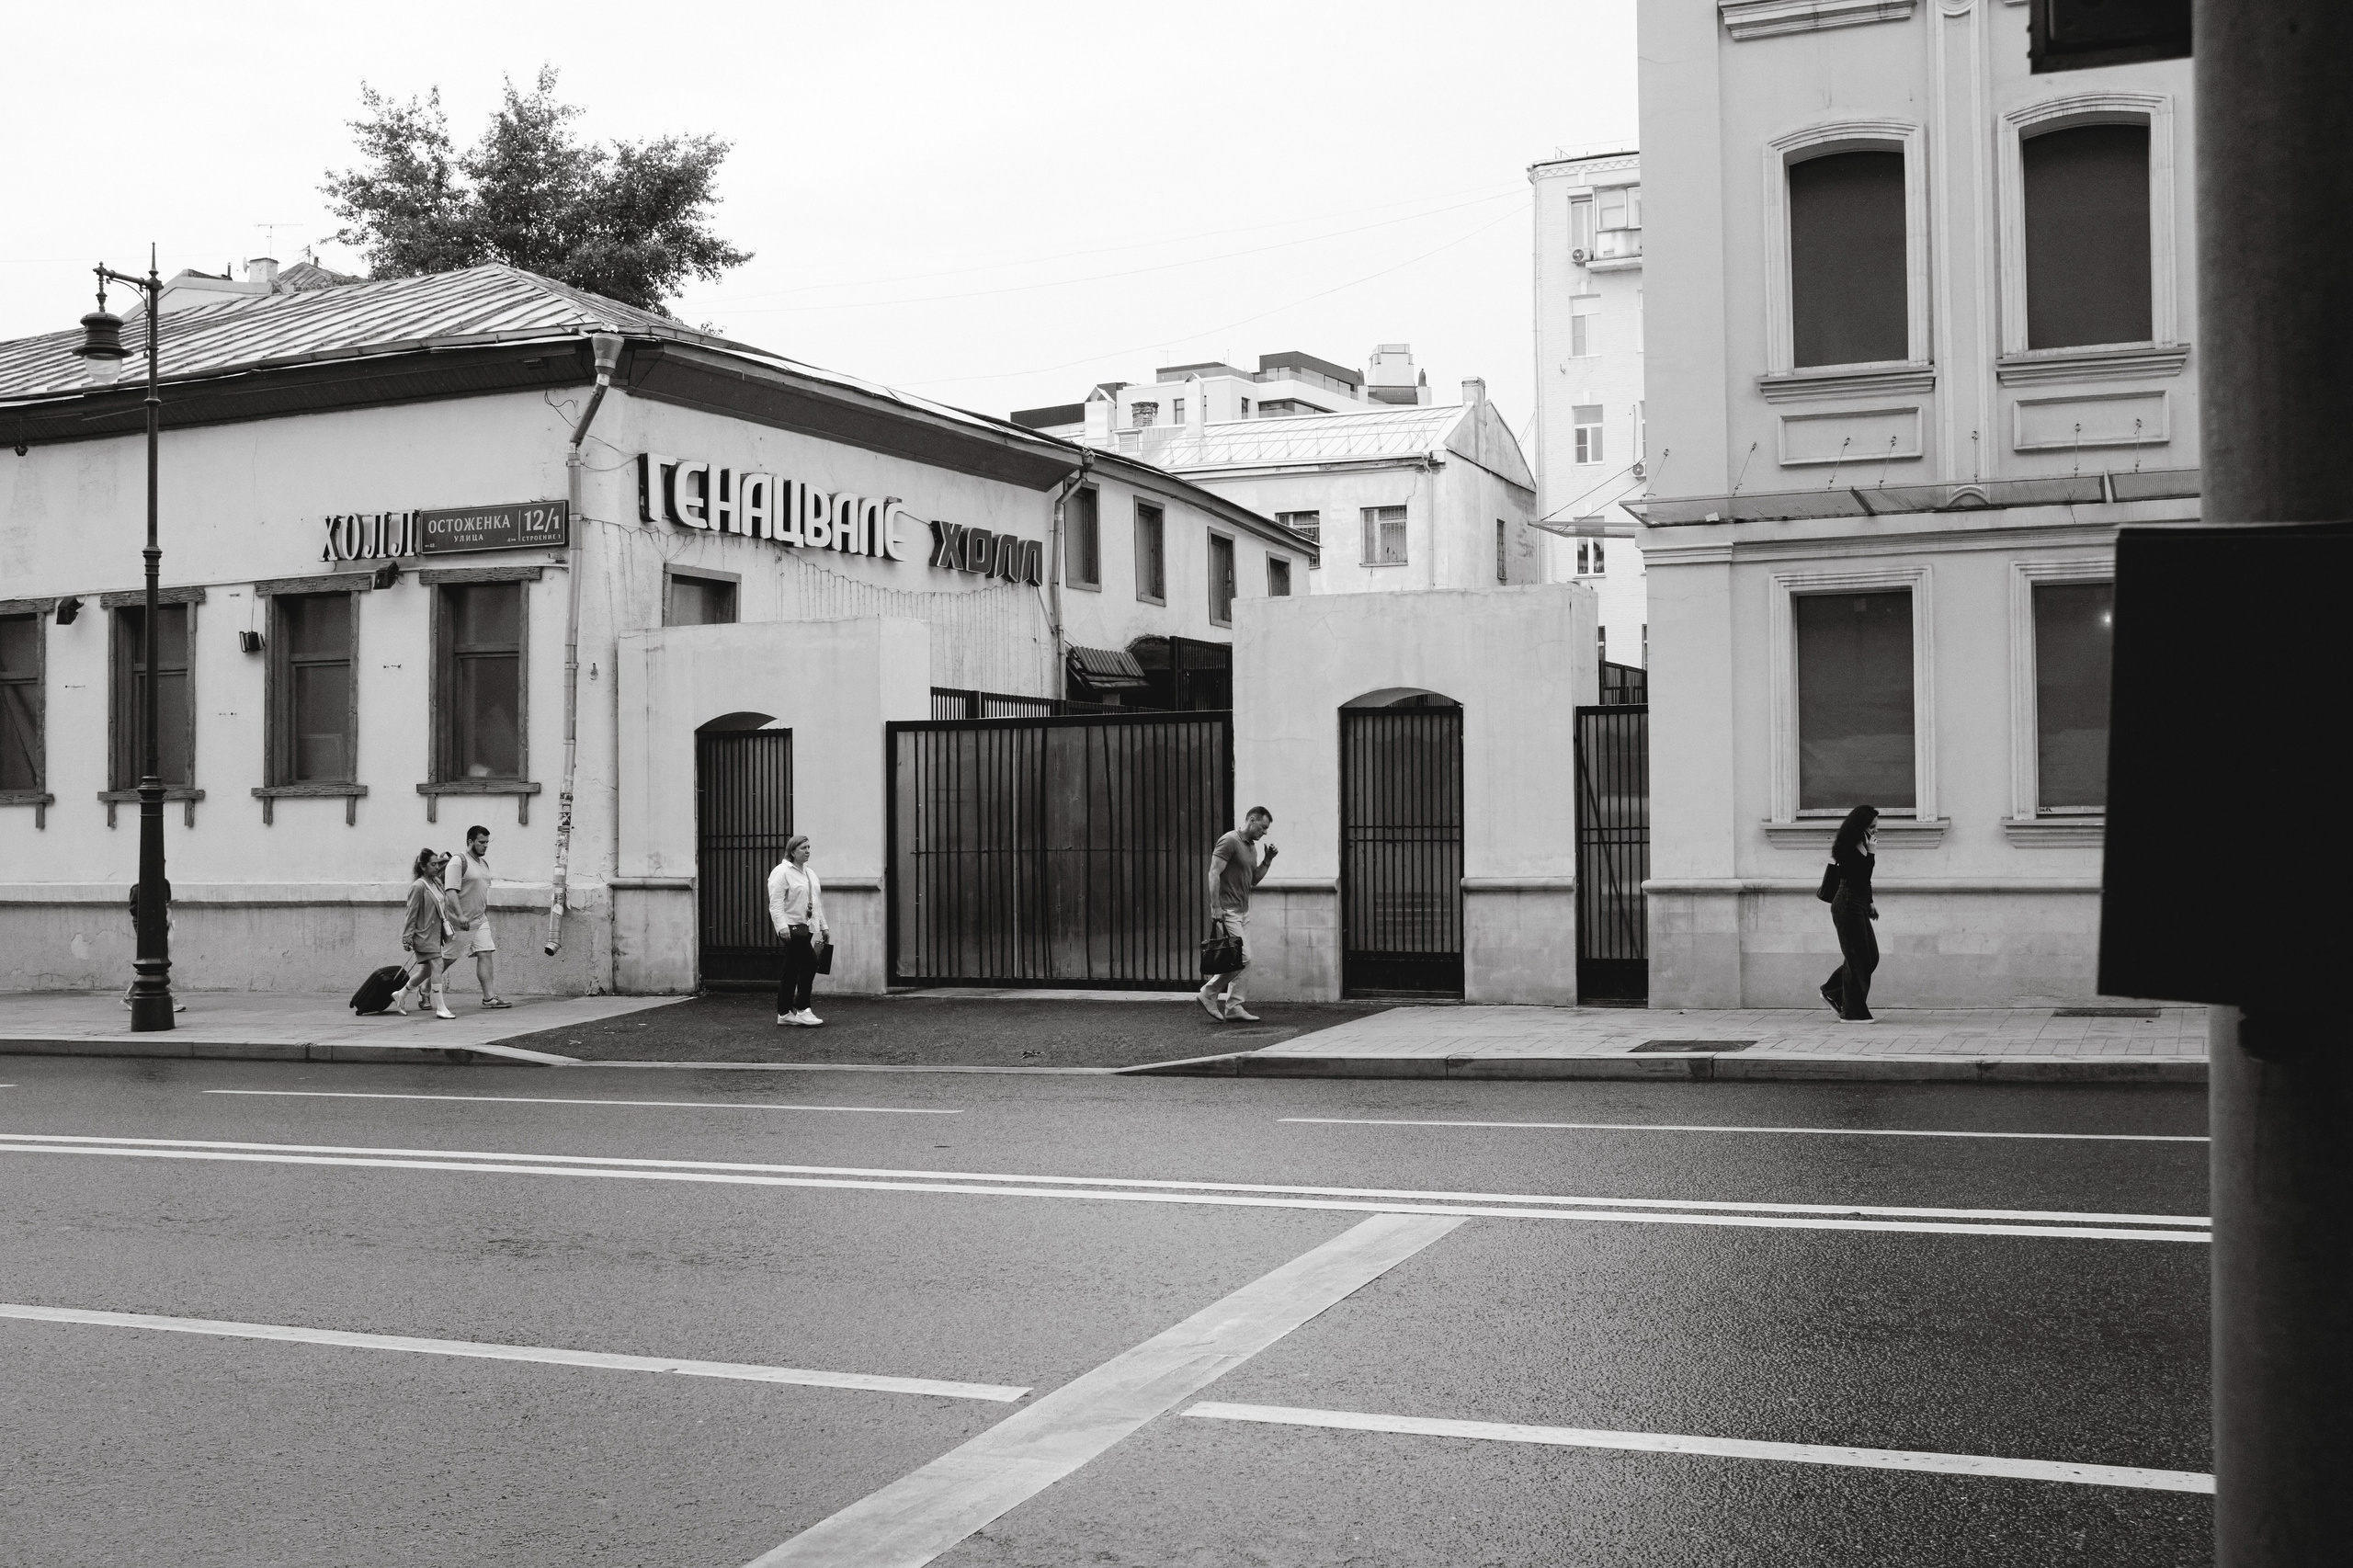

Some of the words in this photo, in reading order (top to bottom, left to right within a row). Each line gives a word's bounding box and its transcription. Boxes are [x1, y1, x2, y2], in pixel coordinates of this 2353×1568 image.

[427, 515, 511, 534] ОСТОЖЕНКА
[524, 507, 560, 533] 12/1
[641, 453, 907, 562] ГЕНАЦВАЛЕ
[932, 520, 1044, 587] ХОЛЛ
[321, 511, 415, 562] ХОЛЛ
[453, 533, 484, 543] УЛИЦА
